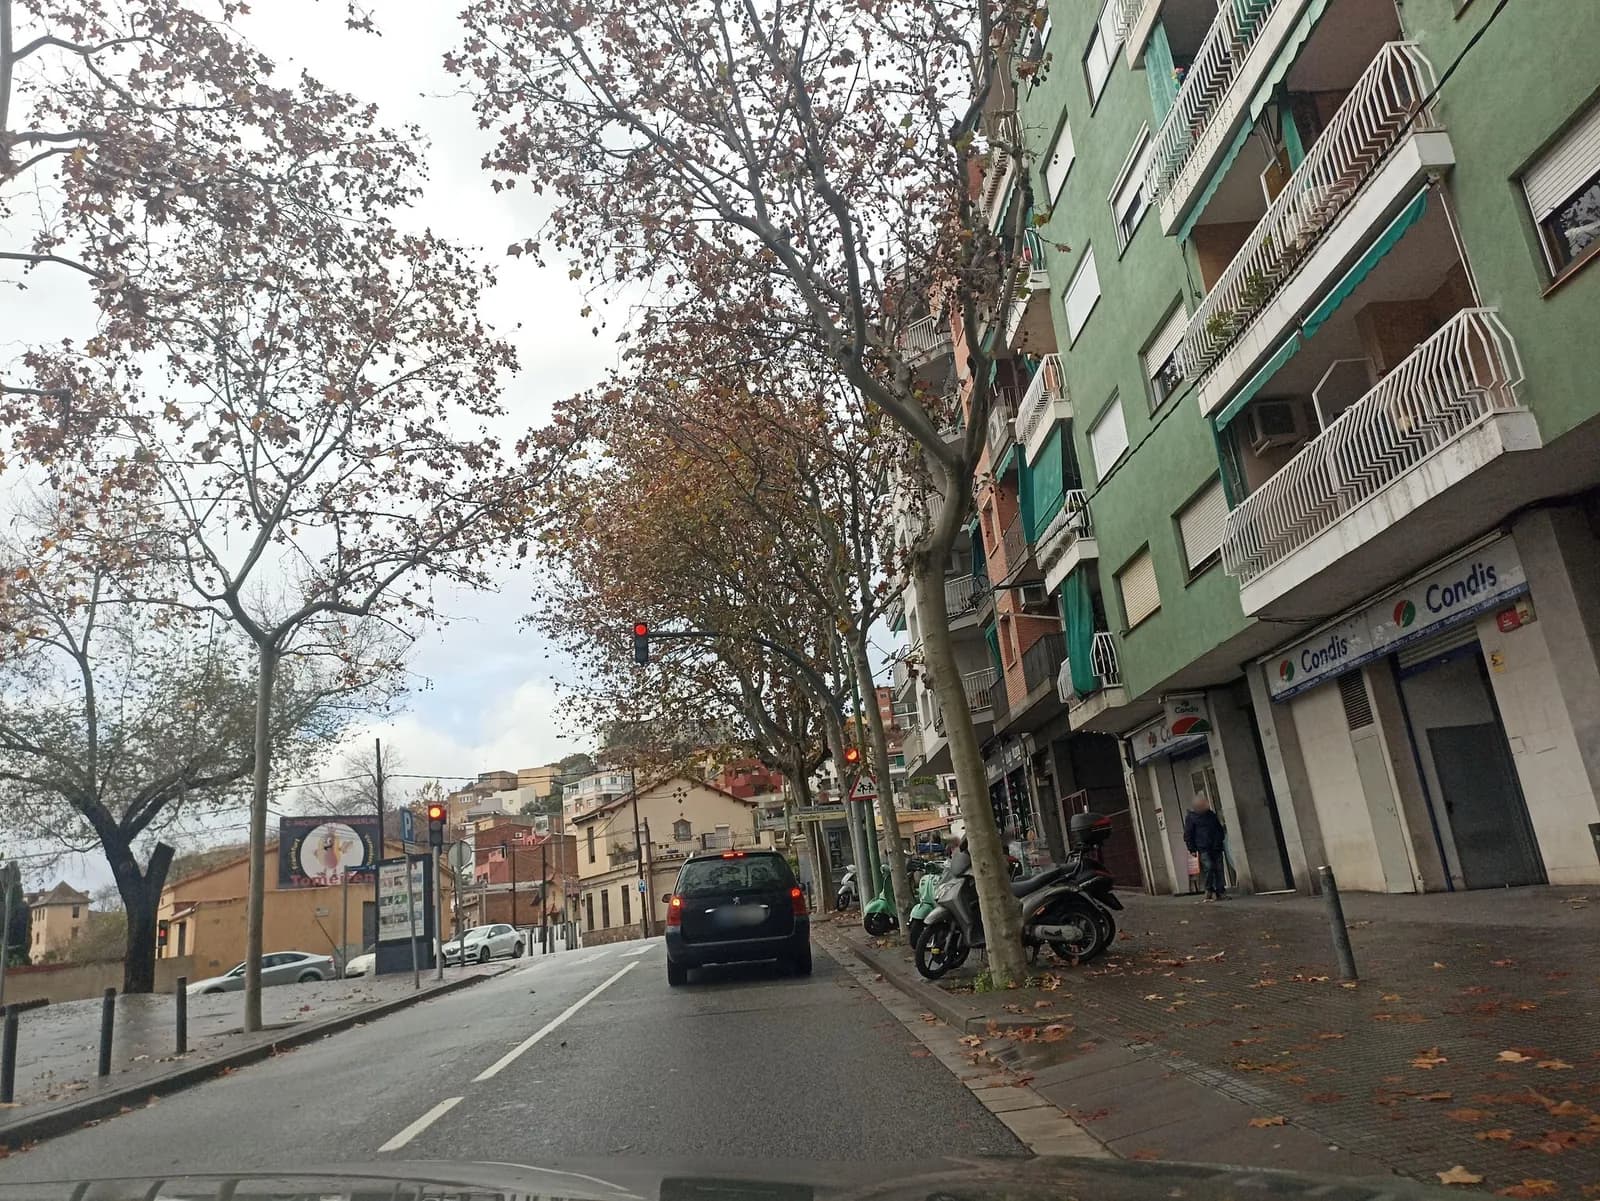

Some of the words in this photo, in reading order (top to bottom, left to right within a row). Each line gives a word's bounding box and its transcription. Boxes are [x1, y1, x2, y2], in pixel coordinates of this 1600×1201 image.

[1426, 562, 1497, 613] Condis
[1301, 635, 1348, 674] Condis
[404, 812, 411, 838] P
